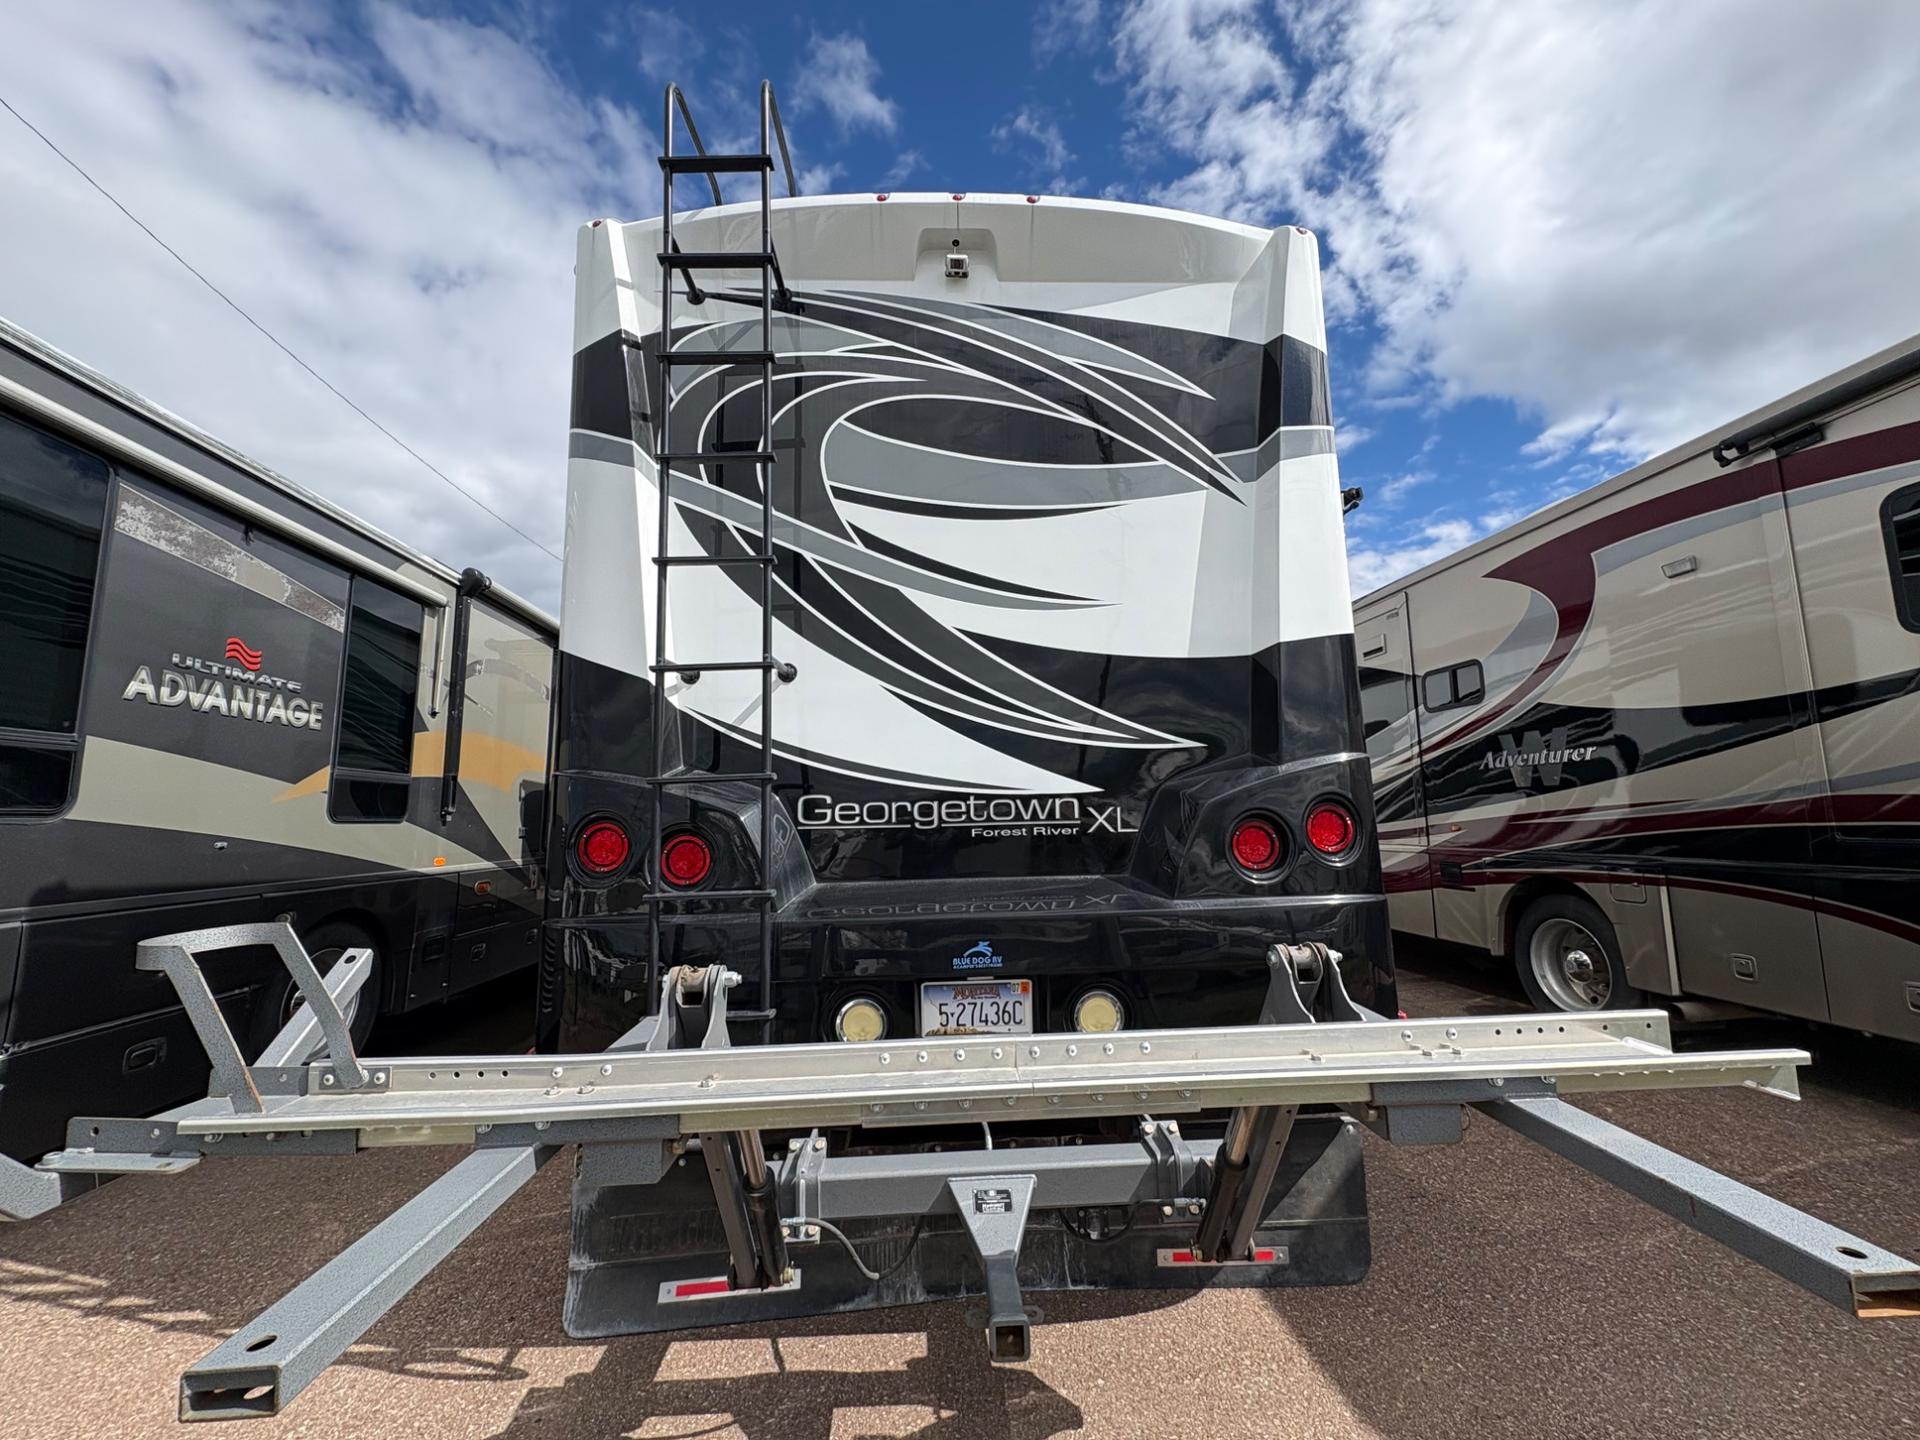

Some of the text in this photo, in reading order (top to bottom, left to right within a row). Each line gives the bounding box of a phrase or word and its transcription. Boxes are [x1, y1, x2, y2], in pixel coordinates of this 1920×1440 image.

[171, 652, 303, 693] ULTIMATE
[121, 664, 325, 731] ADVANTAGE
[1479, 745, 1597, 770] Adventurer
[797, 794, 1140, 833] Georgetown XL
[970, 826, 1080, 838] Forest River
[952, 955, 1003, 965] BLUE DOG RV
